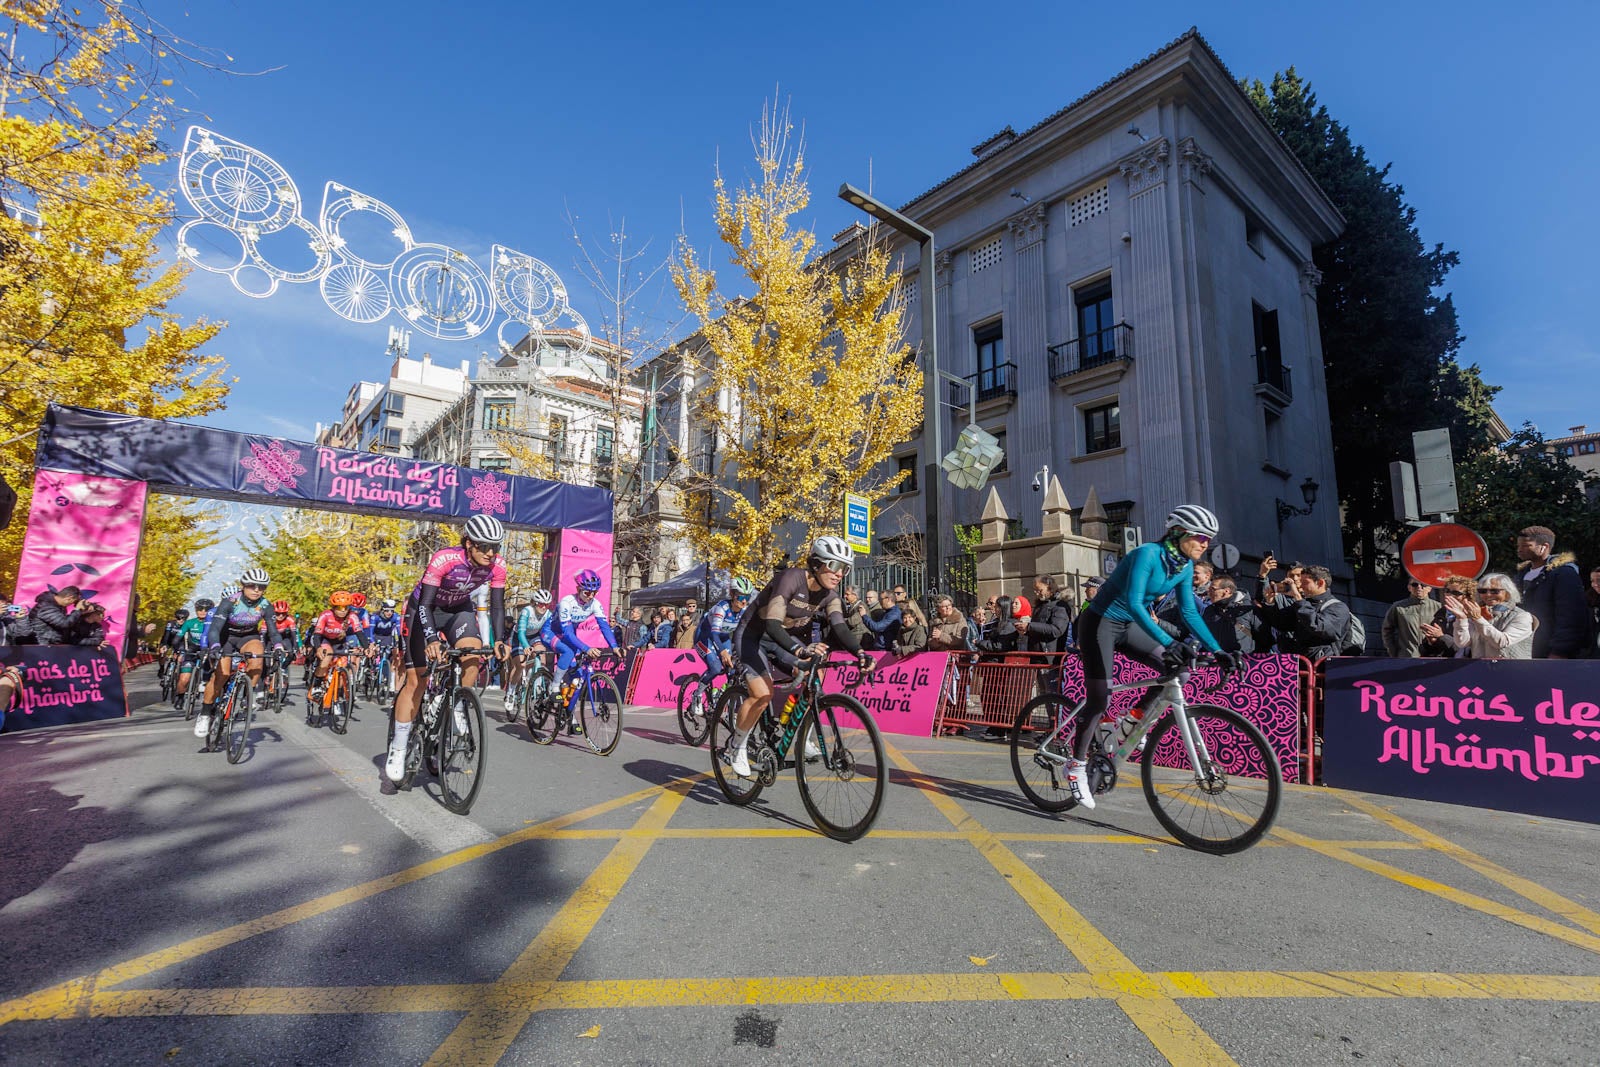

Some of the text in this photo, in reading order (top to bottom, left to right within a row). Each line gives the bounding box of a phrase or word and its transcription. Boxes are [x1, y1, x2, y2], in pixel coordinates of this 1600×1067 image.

[851, 522, 866, 533] TAXI
[67, 659, 91, 679] de
[889, 666, 909, 685] de
[1352, 680, 1524, 725] Reinäs
[1377, 725, 1600, 782] Alhämbr
